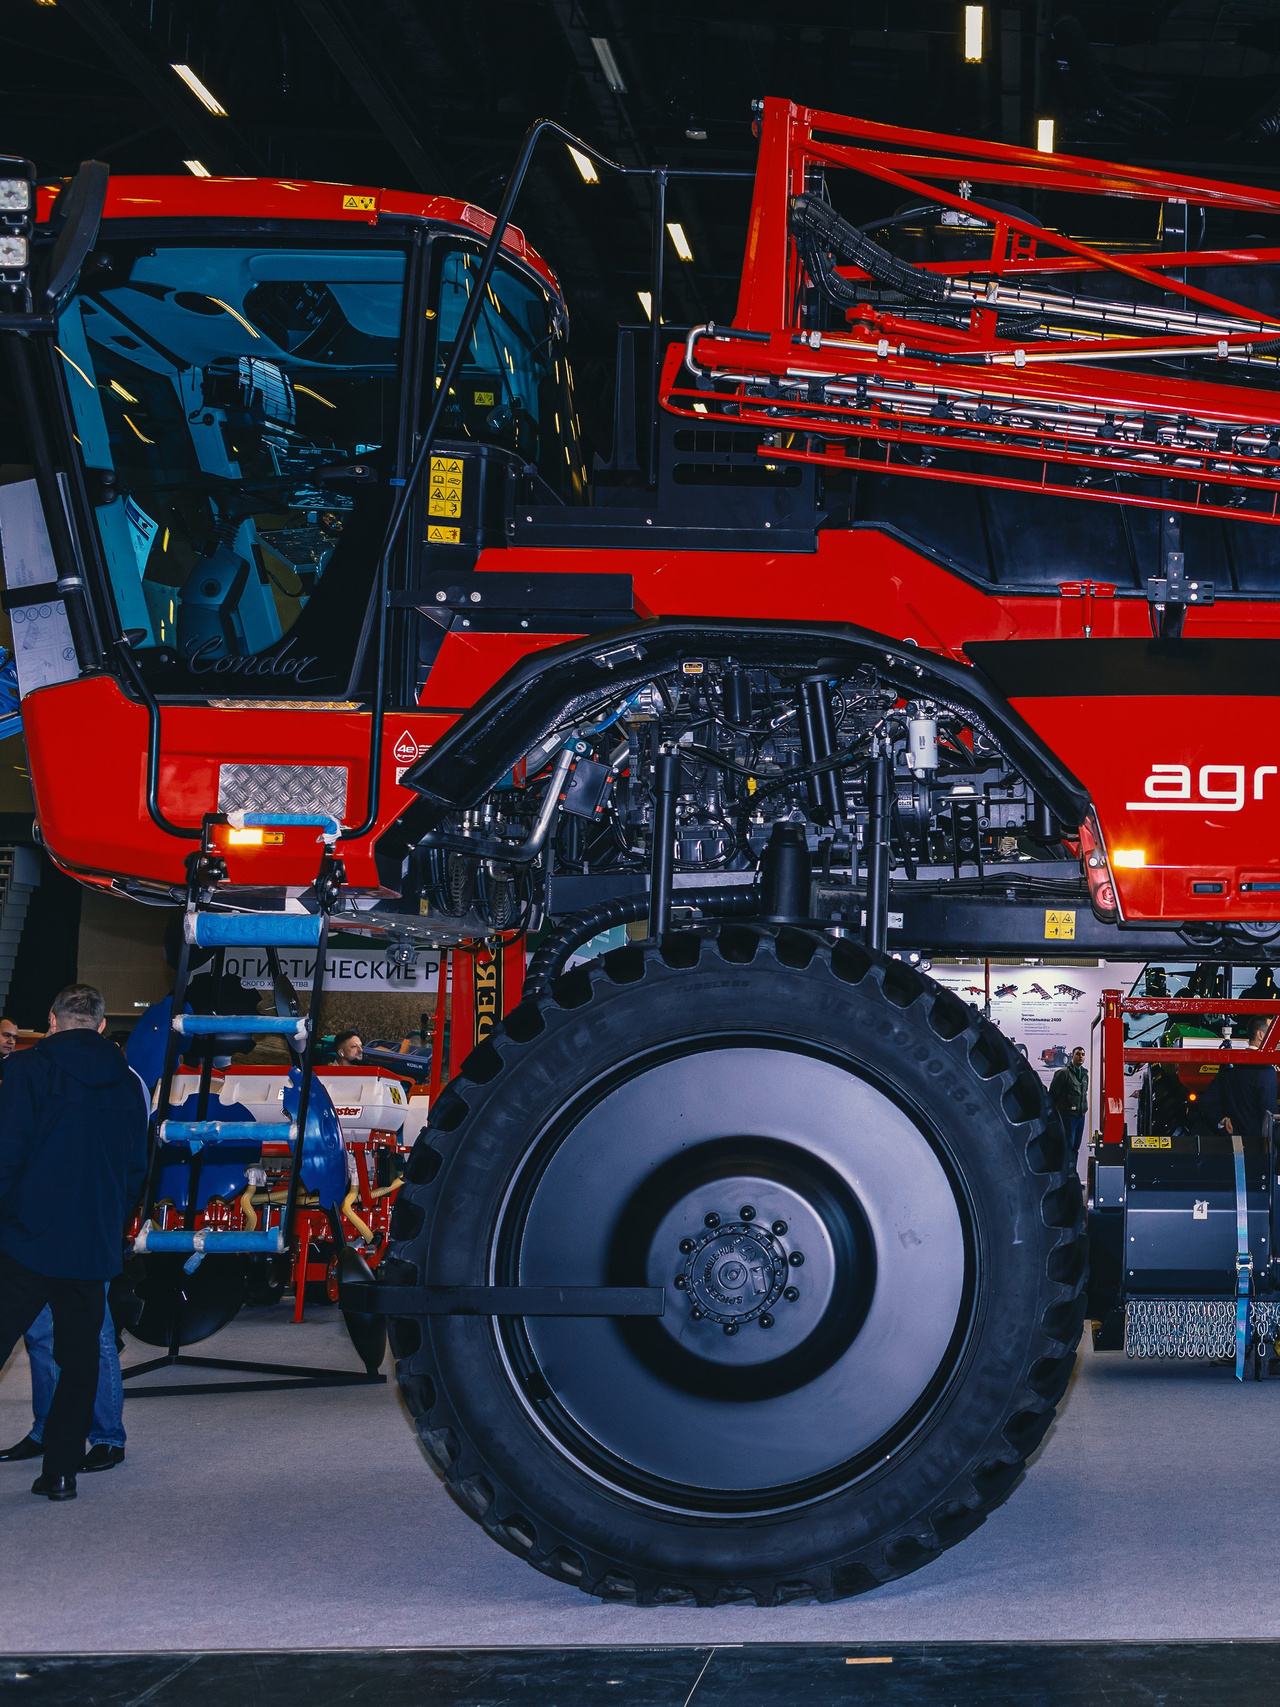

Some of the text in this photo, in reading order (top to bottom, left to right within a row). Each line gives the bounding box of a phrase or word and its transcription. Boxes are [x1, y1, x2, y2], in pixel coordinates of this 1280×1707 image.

[186, 635, 337, 684] Condor
[397, 744, 415, 754] 4e
[672, 979, 751, 995] TUBELESS
[858, 1009, 983, 1119] 380/90R54
[1196, 1203, 1204, 1214] 4
